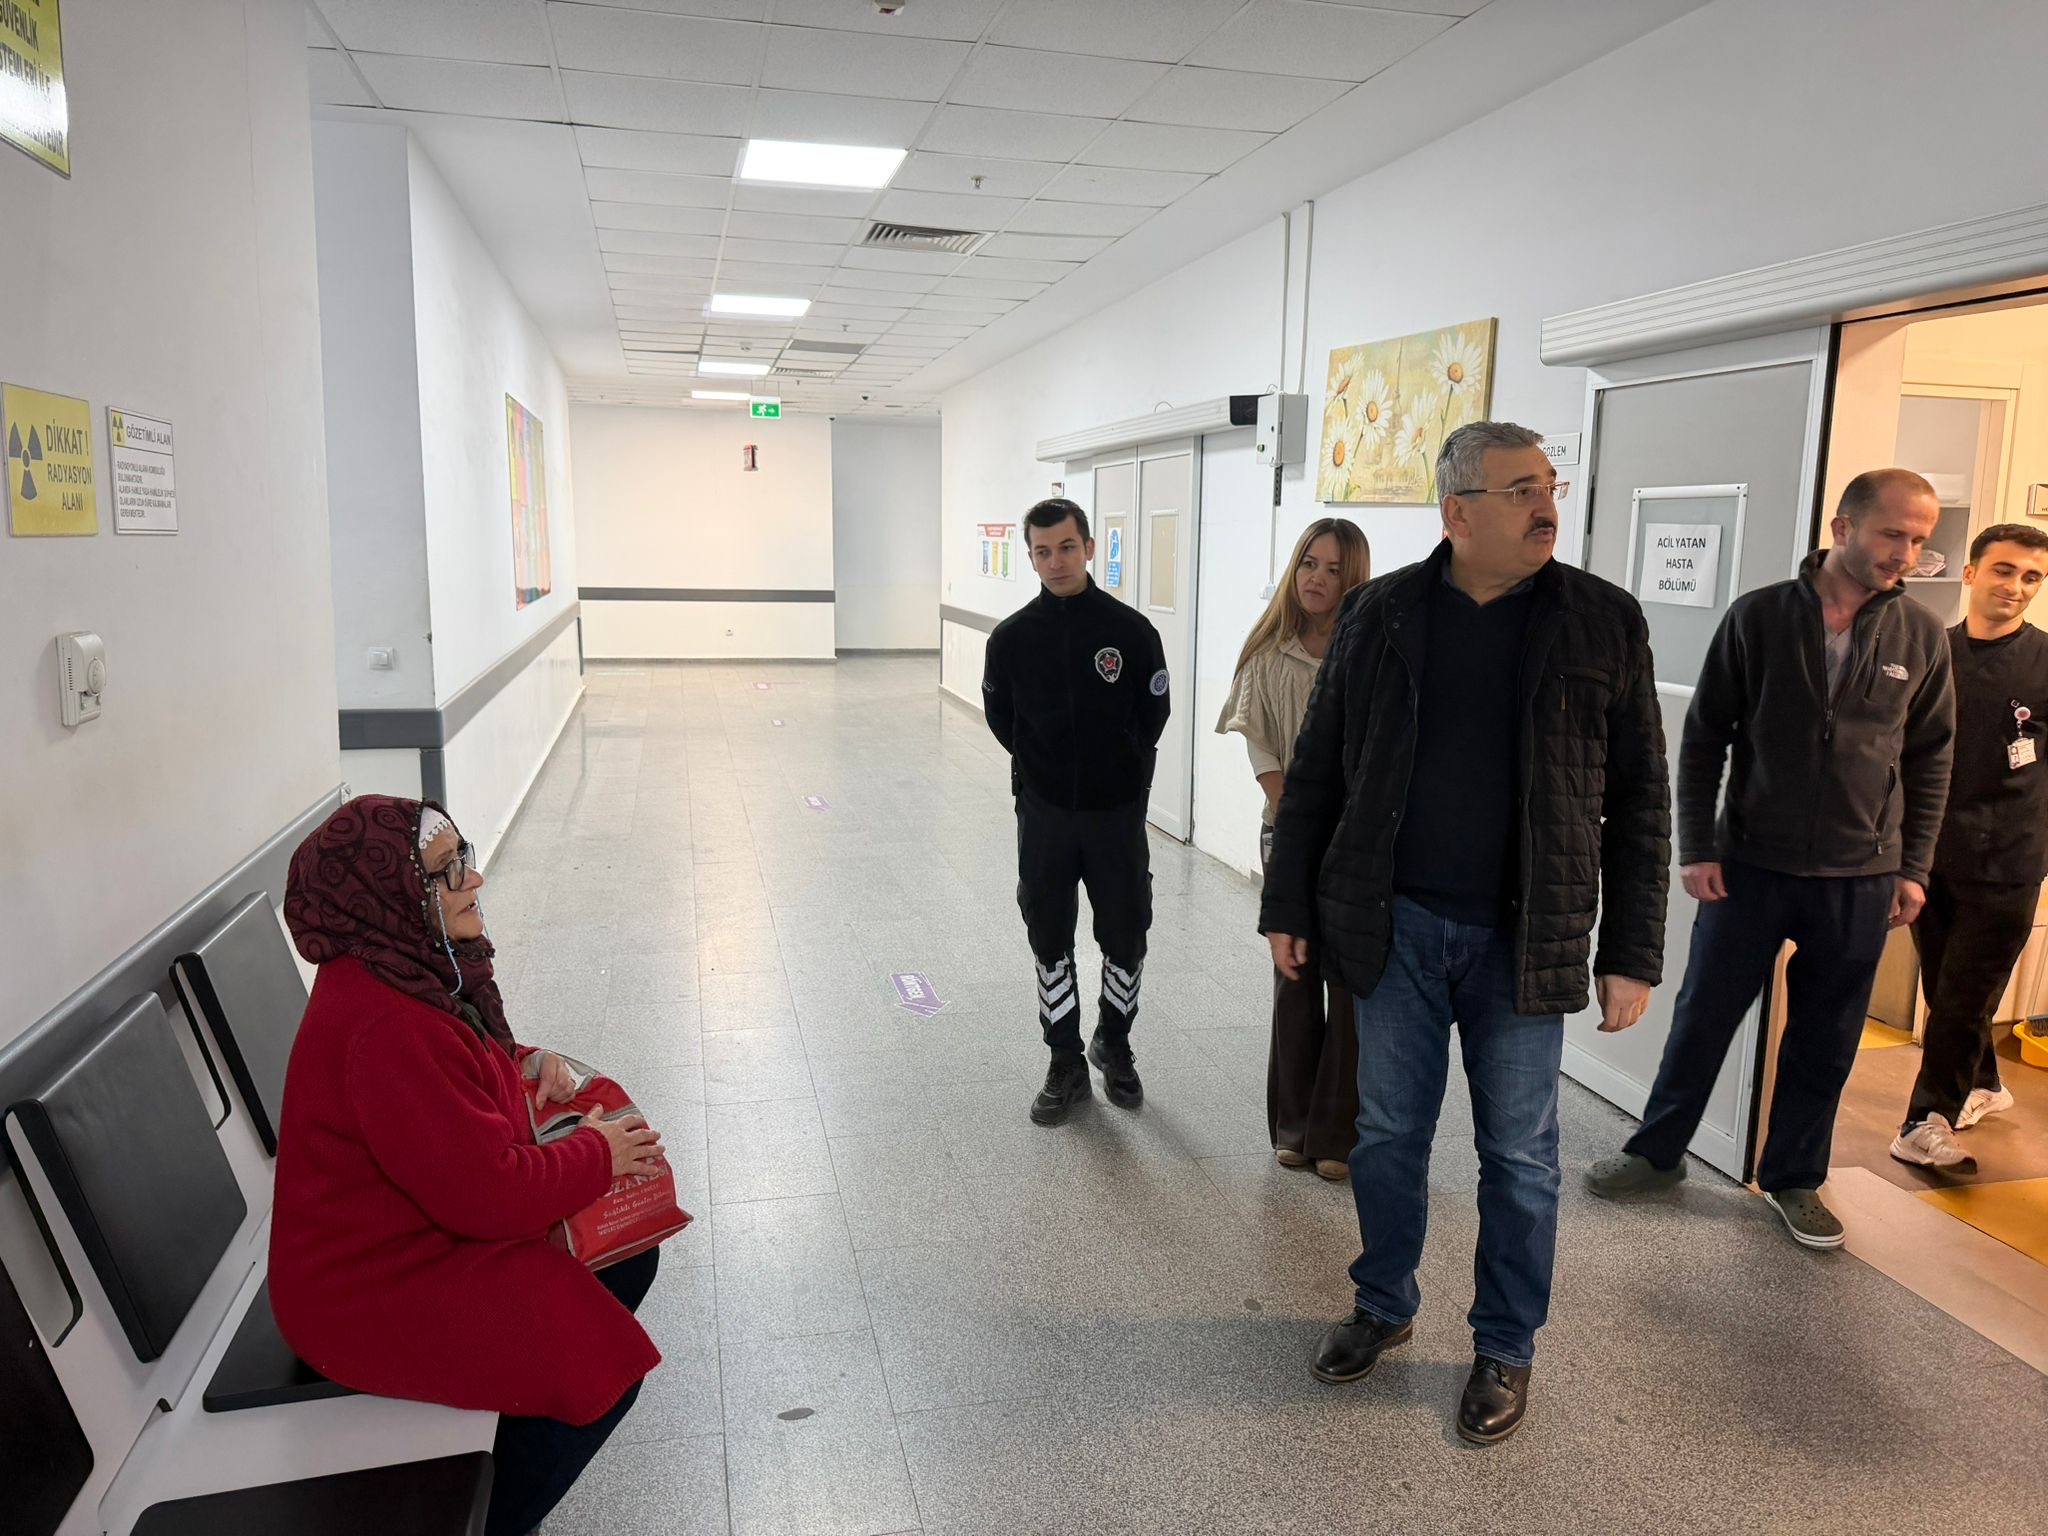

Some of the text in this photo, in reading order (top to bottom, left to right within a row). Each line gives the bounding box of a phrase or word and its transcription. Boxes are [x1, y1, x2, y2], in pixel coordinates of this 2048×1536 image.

[46, 418, 89, 456] DİKKAT !
[127, 423, 171, 446] GÖZETİMLİ ALAN
[47, 463, 92, 485] RADYASYON
[62, 492, 84, 511] ALANI
[1657, 536, 1706, 549] ACİL YATAN
[1666, 558, 1694, 570] HASTA
[1658, 577, 1697, 592] BÖLÜMÜ
